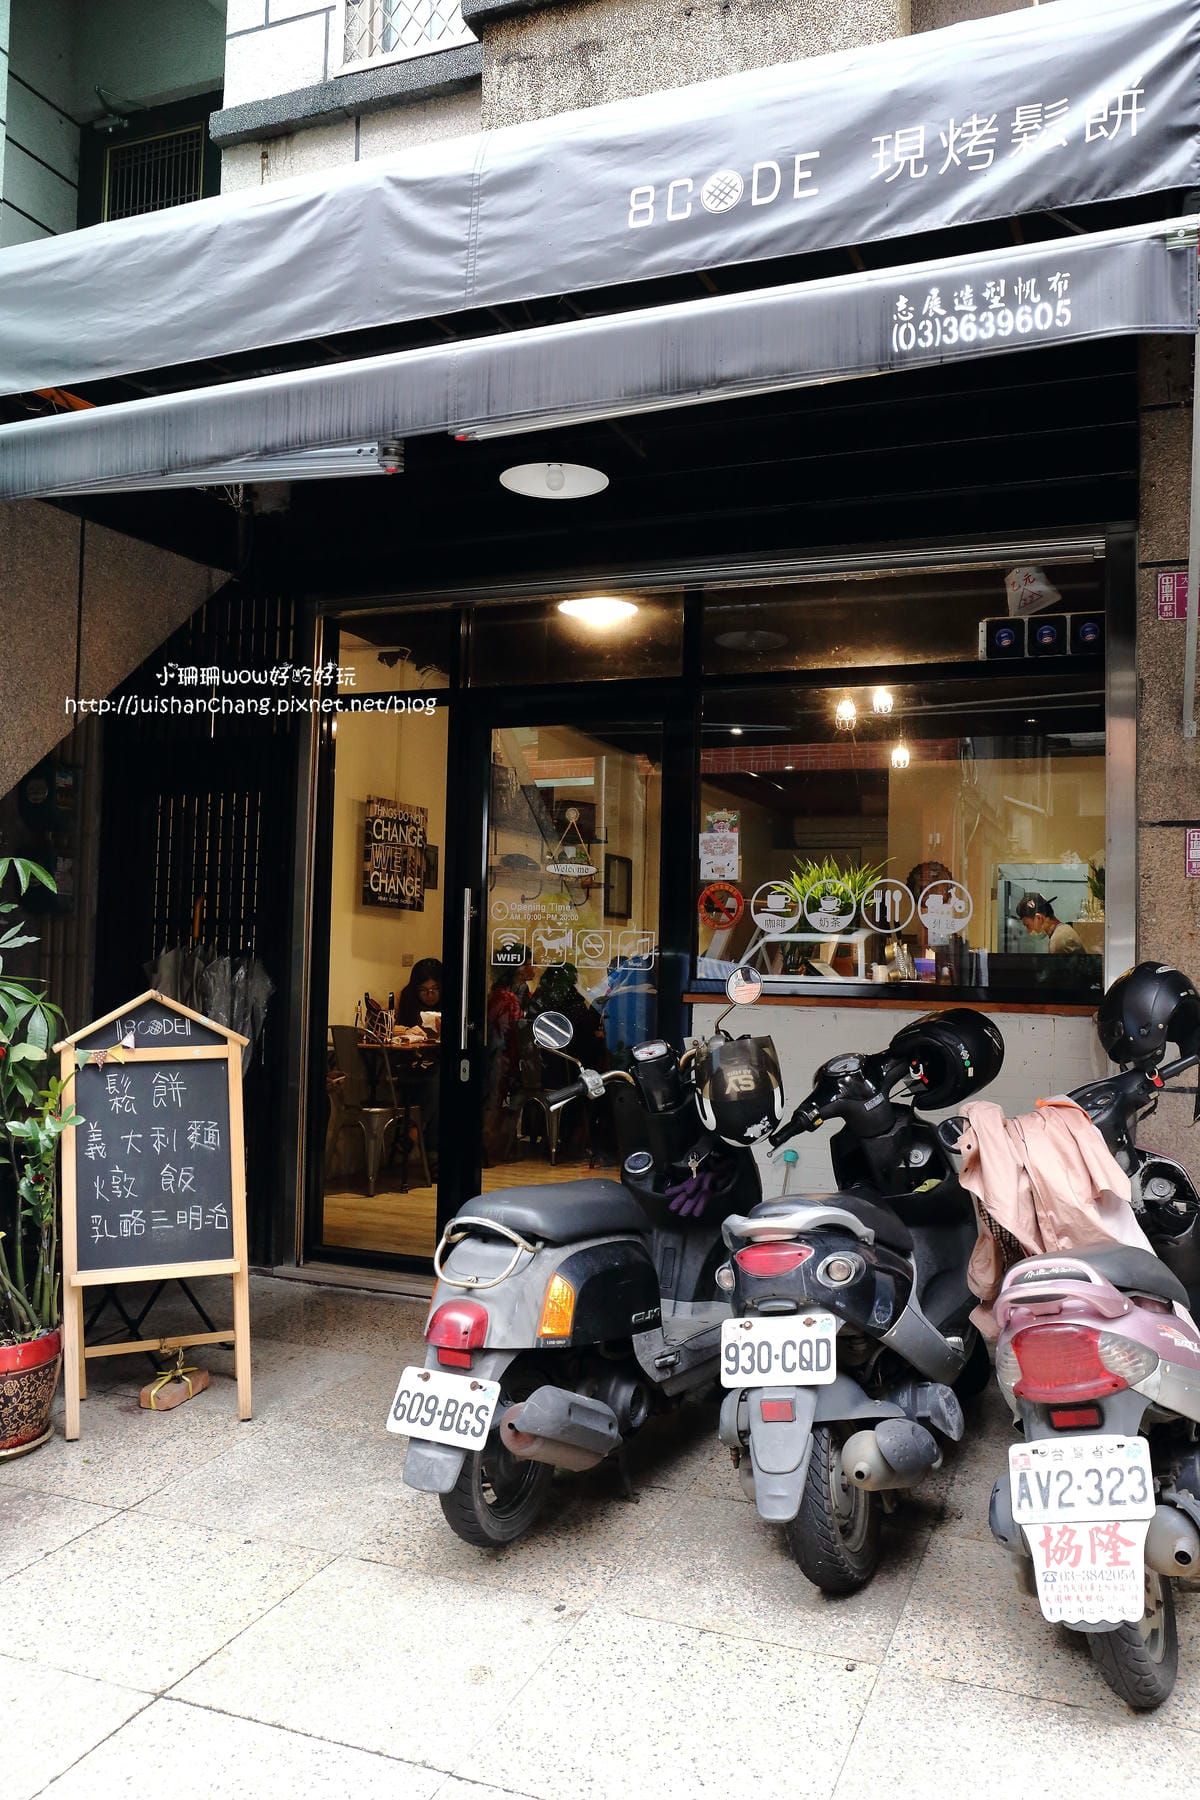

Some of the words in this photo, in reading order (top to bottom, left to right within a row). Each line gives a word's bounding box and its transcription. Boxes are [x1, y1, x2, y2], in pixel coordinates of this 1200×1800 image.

[869, 77, 1147, 185] 現烤鬆餅
[892, 271, 1071, 322] 志展造型帆布
[892, 298, 1072, 353] (03)3639605
[372, 818, 424, 848] CHANGE
[371, 842, 402, 873] WE
[553, 864, 589, 874] Welcome
[369, 870, 421, 898] CHANGE
[510, 902, 546, 912] Opening
[550, 902, 571, 911] Time
[764, 918, 787, 929] 咖啡
[818, 917, 841, 928] 奶茶
[105, 1071, 188, 1115] 鬆餅
[84, 1120, 221, 1160] 義大利麵
[90, 1203, 229, 1244] 乳酪三明治
[1038, 1521, 1137, 1569] 協隆
